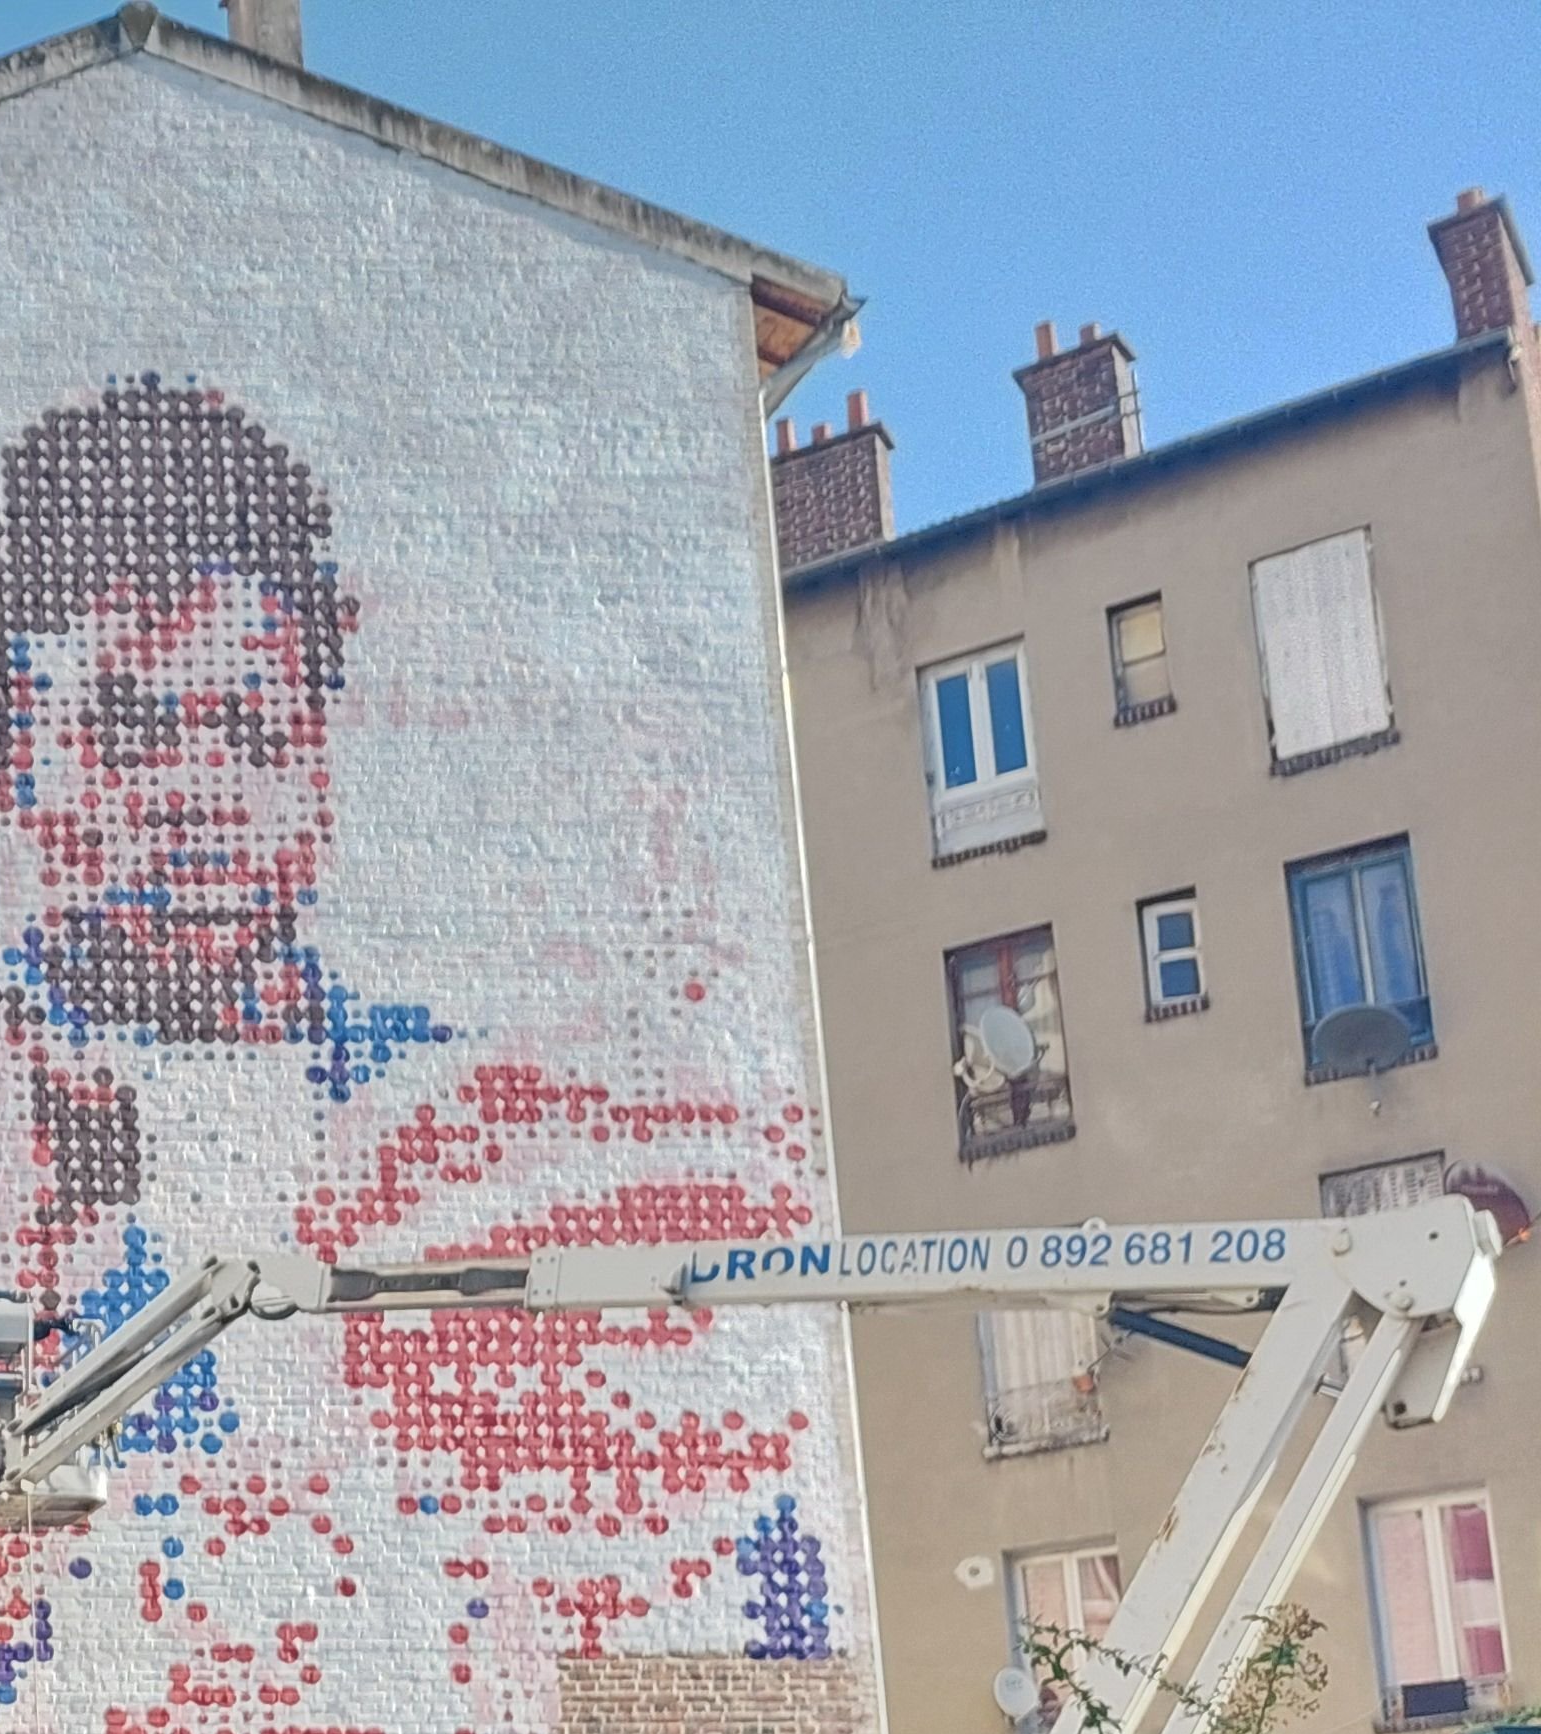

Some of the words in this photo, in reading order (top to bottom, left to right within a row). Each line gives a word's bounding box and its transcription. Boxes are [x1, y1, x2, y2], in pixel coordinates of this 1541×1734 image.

[839, 1237, 990, 1276] LOCATION
[1006, 1235, 1028, 1269] 0
[1039, 1234, 1112, 1267] 892
[1123, 1231, 1193, 1265] 681
[1209, 1228, 1287, 1263] 208
